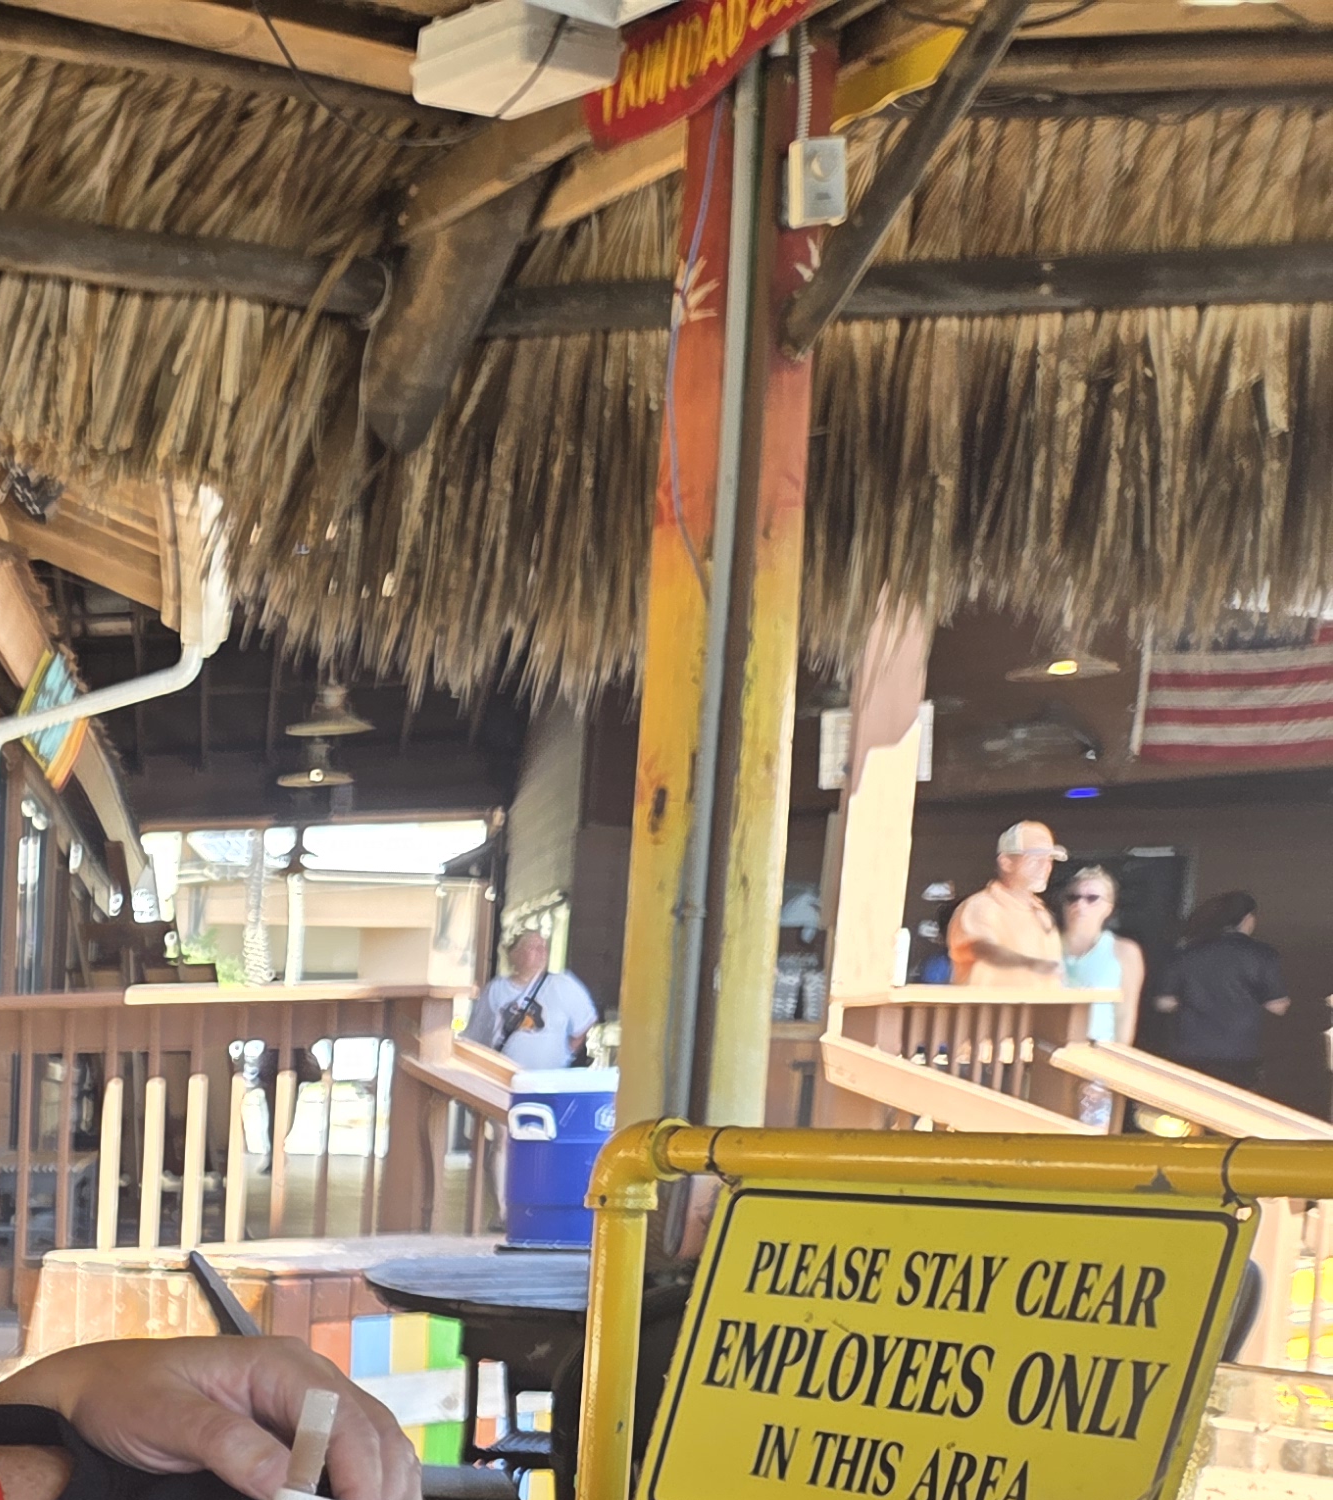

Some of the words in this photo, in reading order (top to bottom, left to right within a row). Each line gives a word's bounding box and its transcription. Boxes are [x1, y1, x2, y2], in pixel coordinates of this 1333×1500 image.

[744, 1241, 891, 1305] PLEASE
[897, 1250, 1009, 1314] STAY
[1014, 1260, 1167, 1329] CLEAR
[702, 1319, 994, 1418] EMPLOYEES
[1007, 1352, 1169, 1441] ONLY
[749, 1424, 799, 1480] IN
[807, 1431, 904, 1497] THIS
